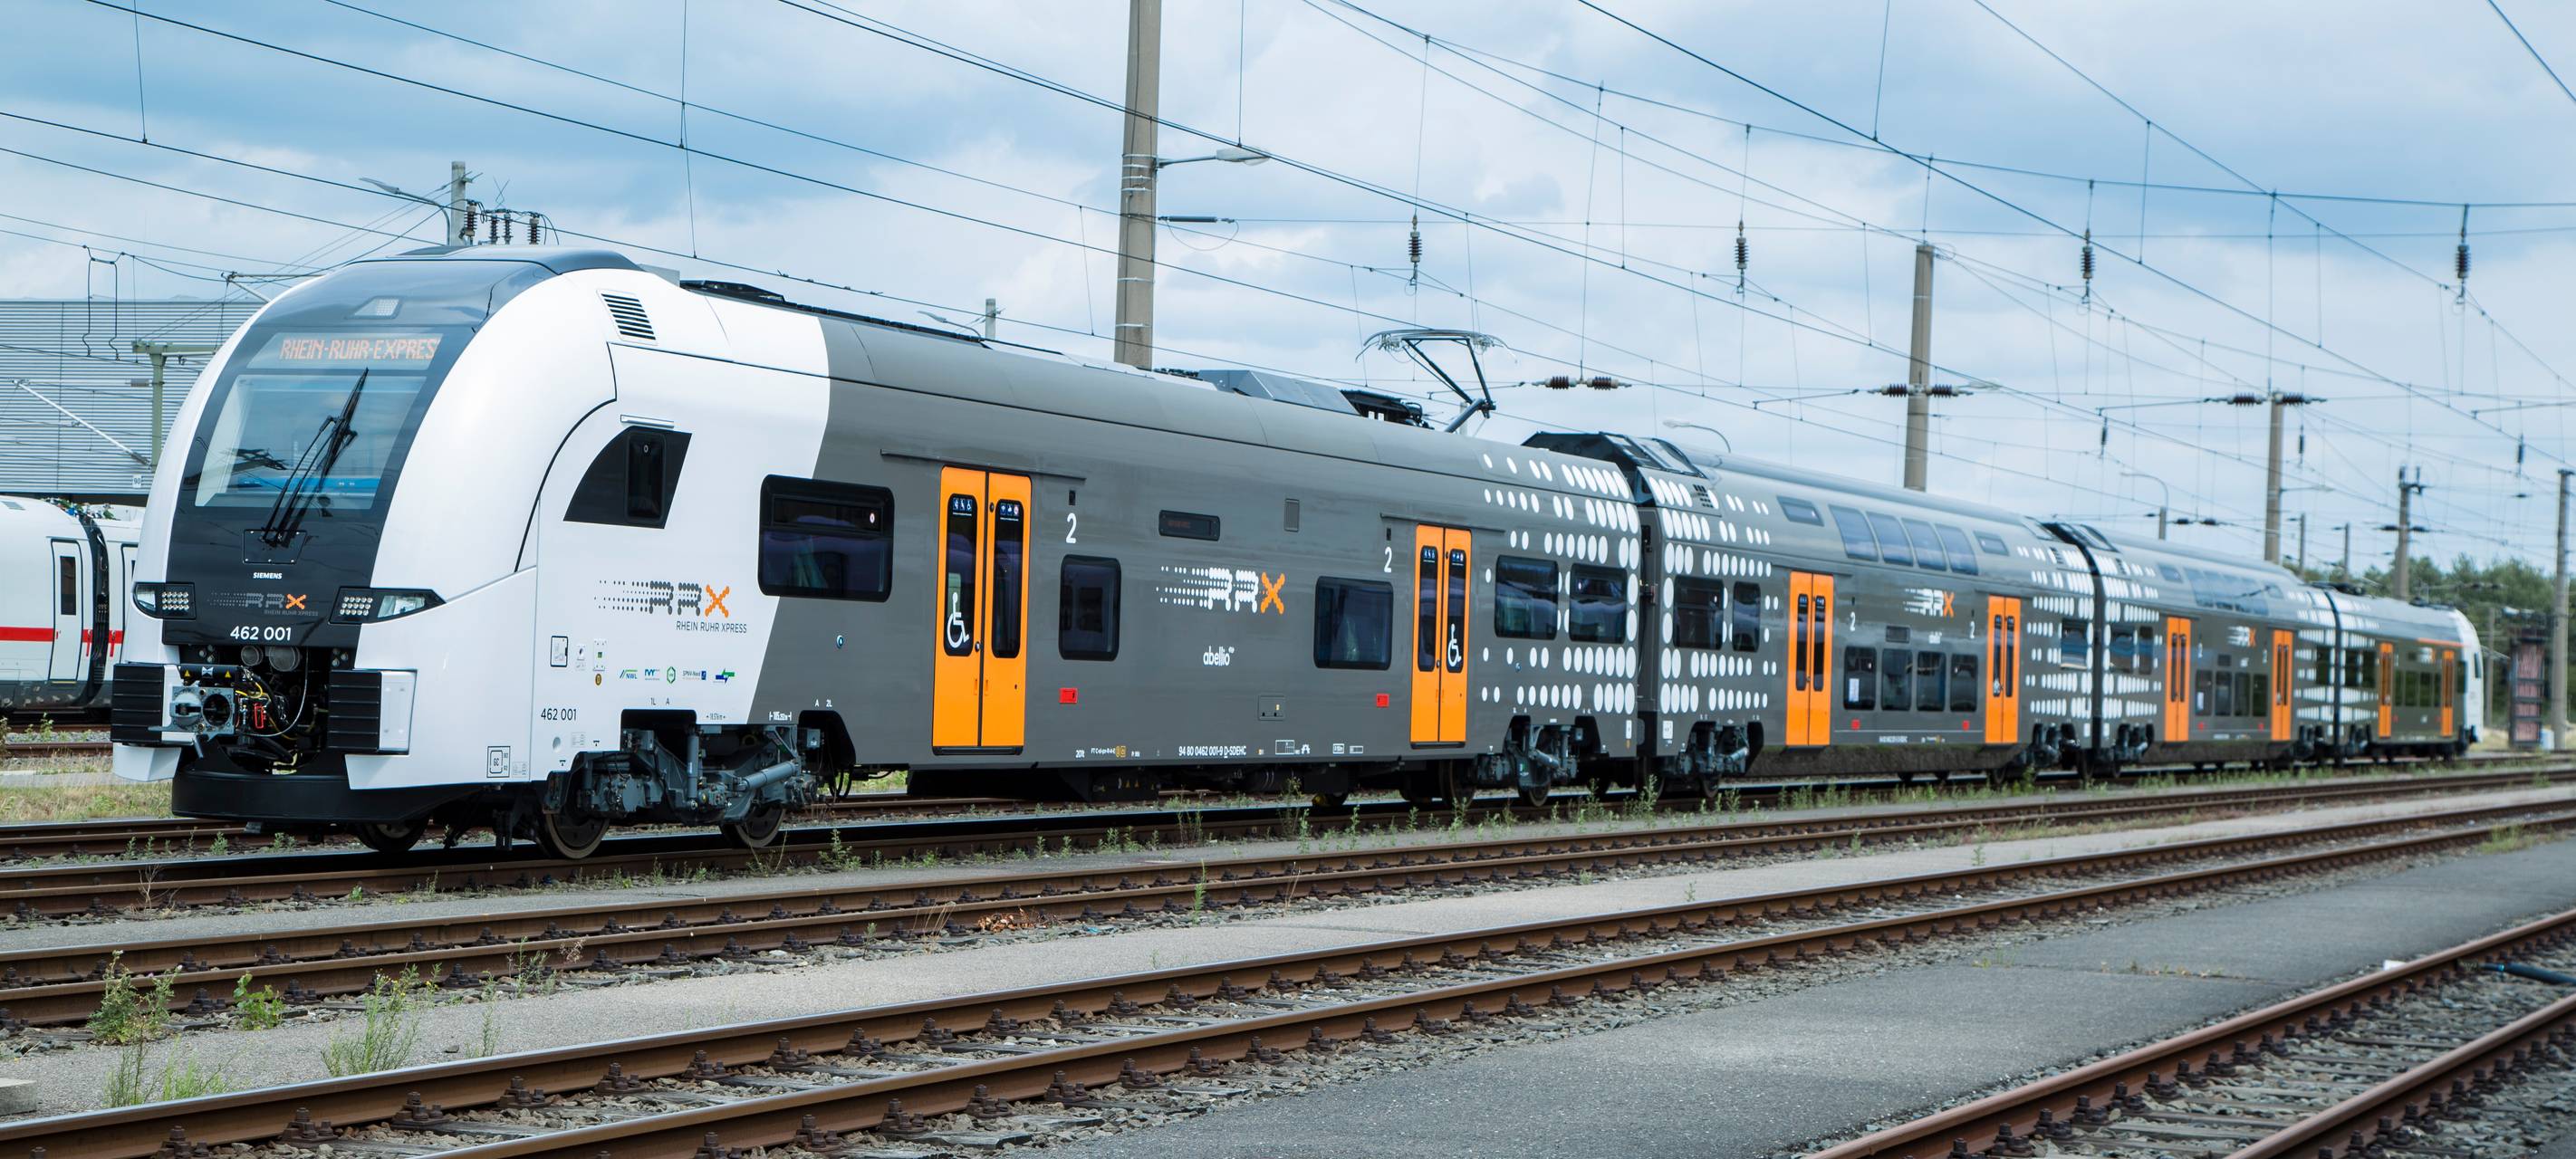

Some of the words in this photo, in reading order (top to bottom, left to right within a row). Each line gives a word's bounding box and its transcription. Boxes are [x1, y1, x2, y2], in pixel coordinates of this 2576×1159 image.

[1065, 512, 1077, 544] 2
[1383, 546, 1392, 573] 2
[649, 580, 730, 618] RRX
[1207, 567, 1285, 615] RRX
[245, 593, 307, 609] RRX
[676, 620, 698, 631] RHEIN
[700, 621, 720, 632] RUHR
[721, 622, 747, 634] XPRESS
[1850, 611, 1856, 632] 2
[1969, 620, 1975, 639] 2
[229, 626, 259, 640] 462
[264, 627, 292, 641] 001
[1203, 646, 1230, 666] abellio
[666, 697, 670, 705] A
[814, 698, 820, 707] A
[541, 708, 558, 721] 462
[561, 708, 577, 722] 001
[1178, 745, 1187, 756] 94
[1187, 745, 1194, 756] 80
[1195, 745, 1208, 756] 0462
[1208, 745, 1224, 756] 001-9
